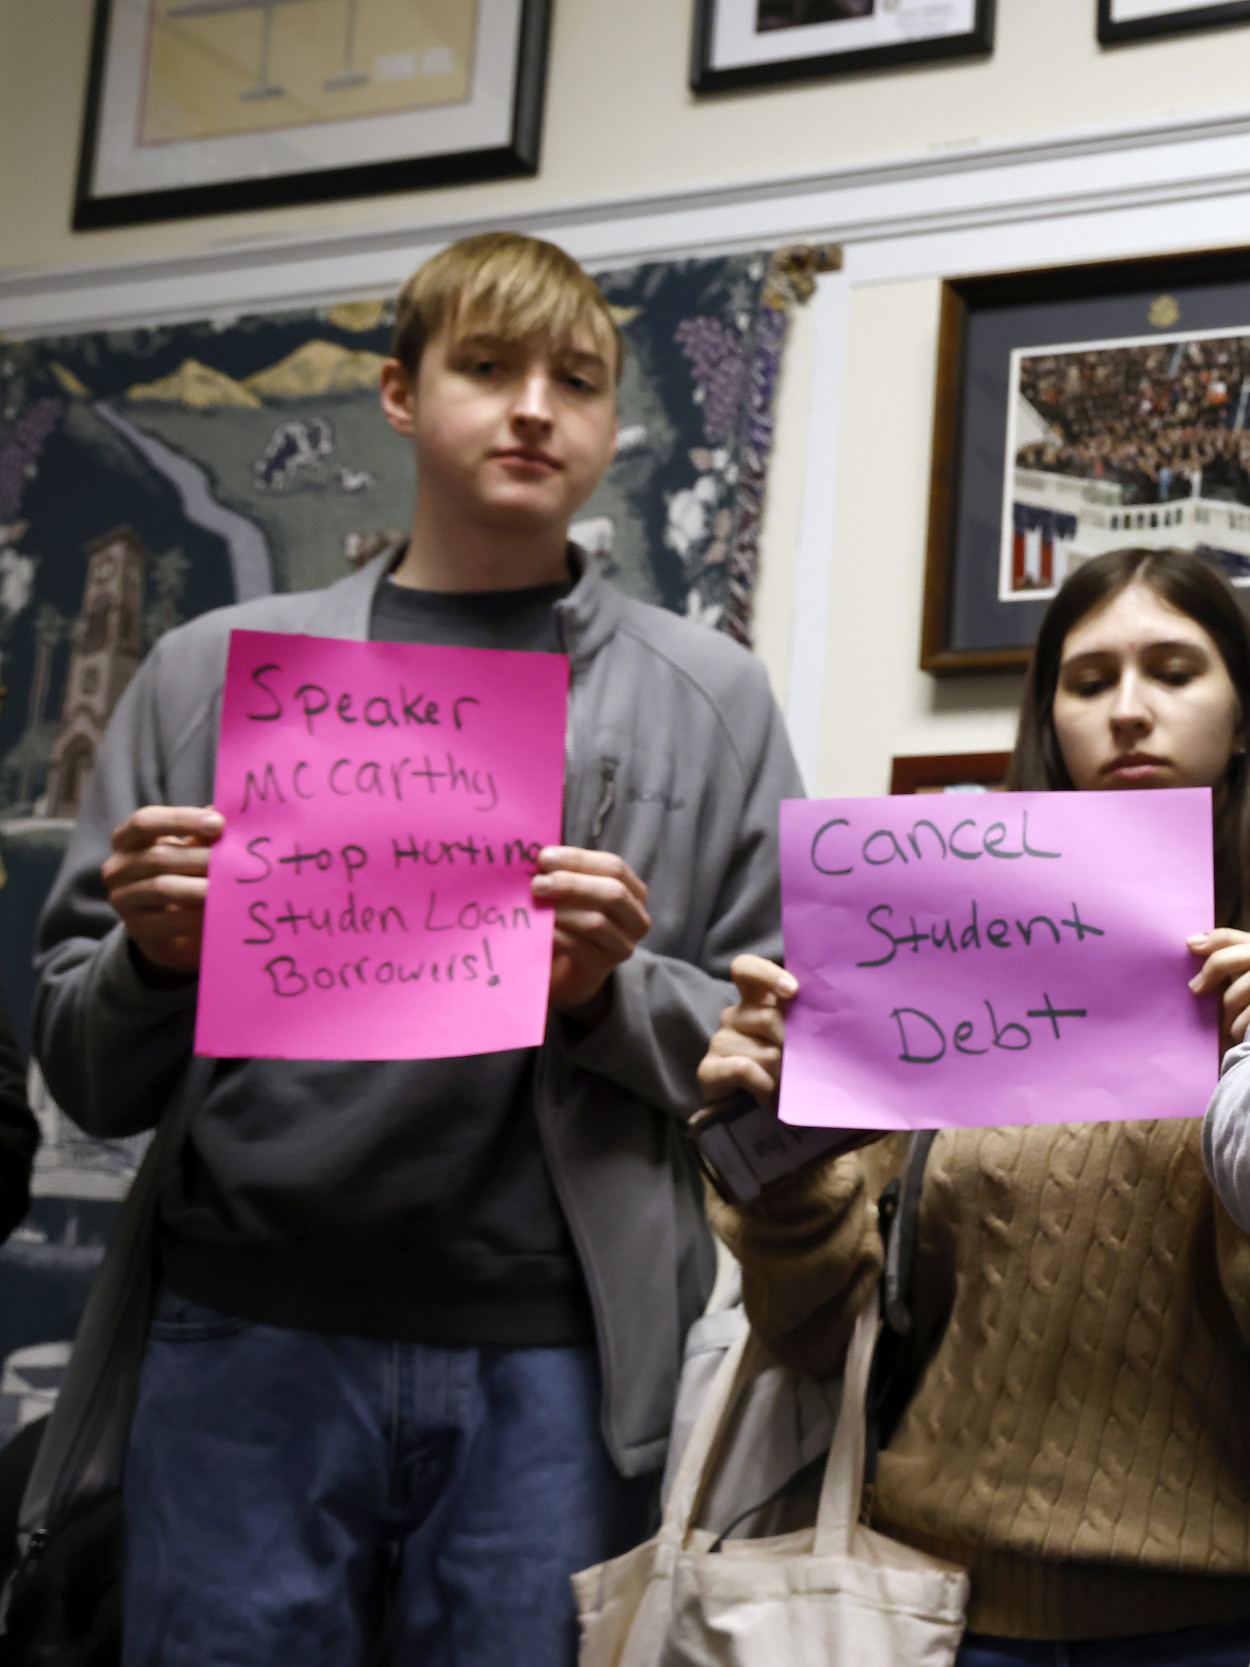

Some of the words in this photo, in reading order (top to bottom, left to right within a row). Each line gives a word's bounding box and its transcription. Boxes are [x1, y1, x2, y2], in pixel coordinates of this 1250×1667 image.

[247, 664, 480, 735] Speaker
[236, 836, 367, 883] Stop
[810, 810, 1062, 876] Cancel
[243, 892, 408, 945] Studen
[425, 889, 531, 932] Loan
[856, 900, 1105, 967] Student
[891, 992, 1087, 1064] Debt
